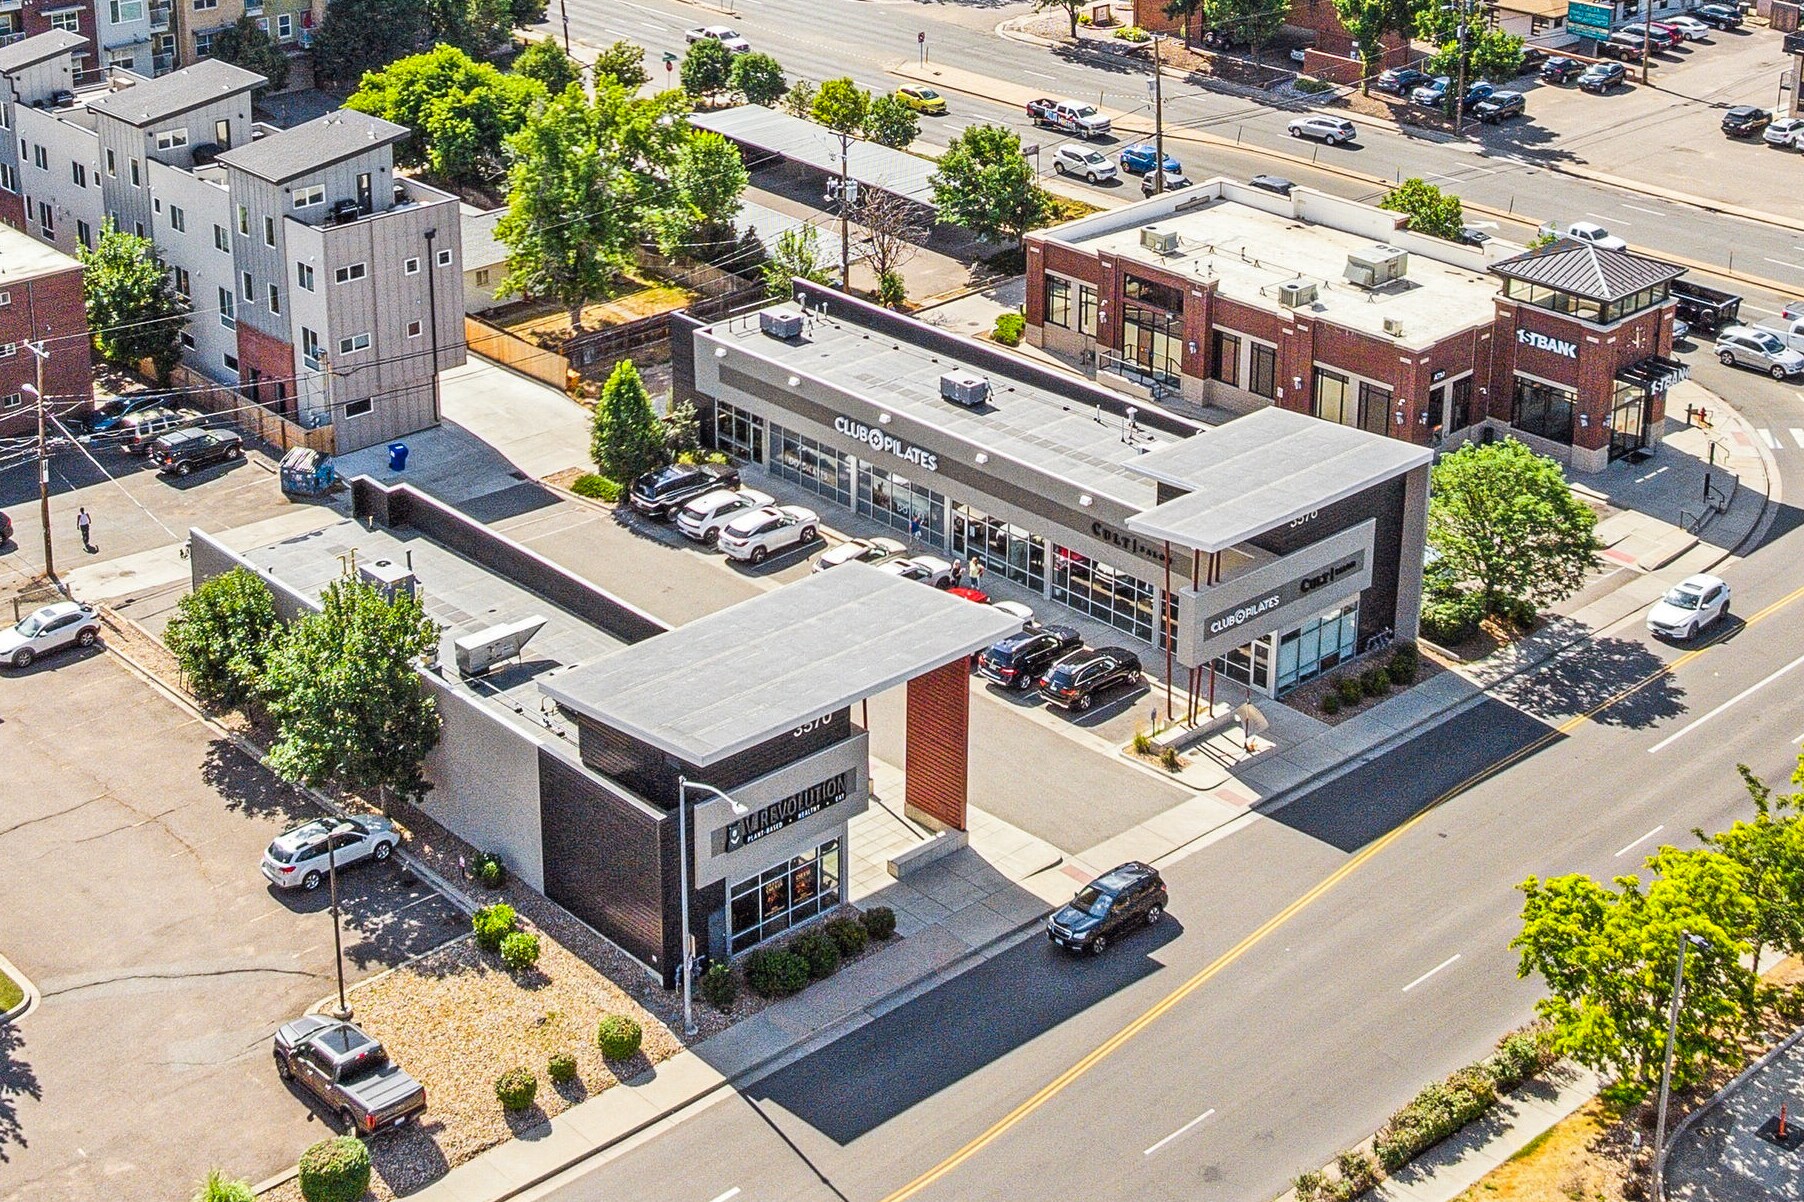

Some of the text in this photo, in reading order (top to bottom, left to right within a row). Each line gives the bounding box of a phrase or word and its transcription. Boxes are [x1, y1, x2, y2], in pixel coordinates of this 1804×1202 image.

[834, 416, 938, 471] CLUB PILATES
[1210, 595, 1280, 633] CLUB PILATES
[747, 822, 783, 842] PLANT-BASED
